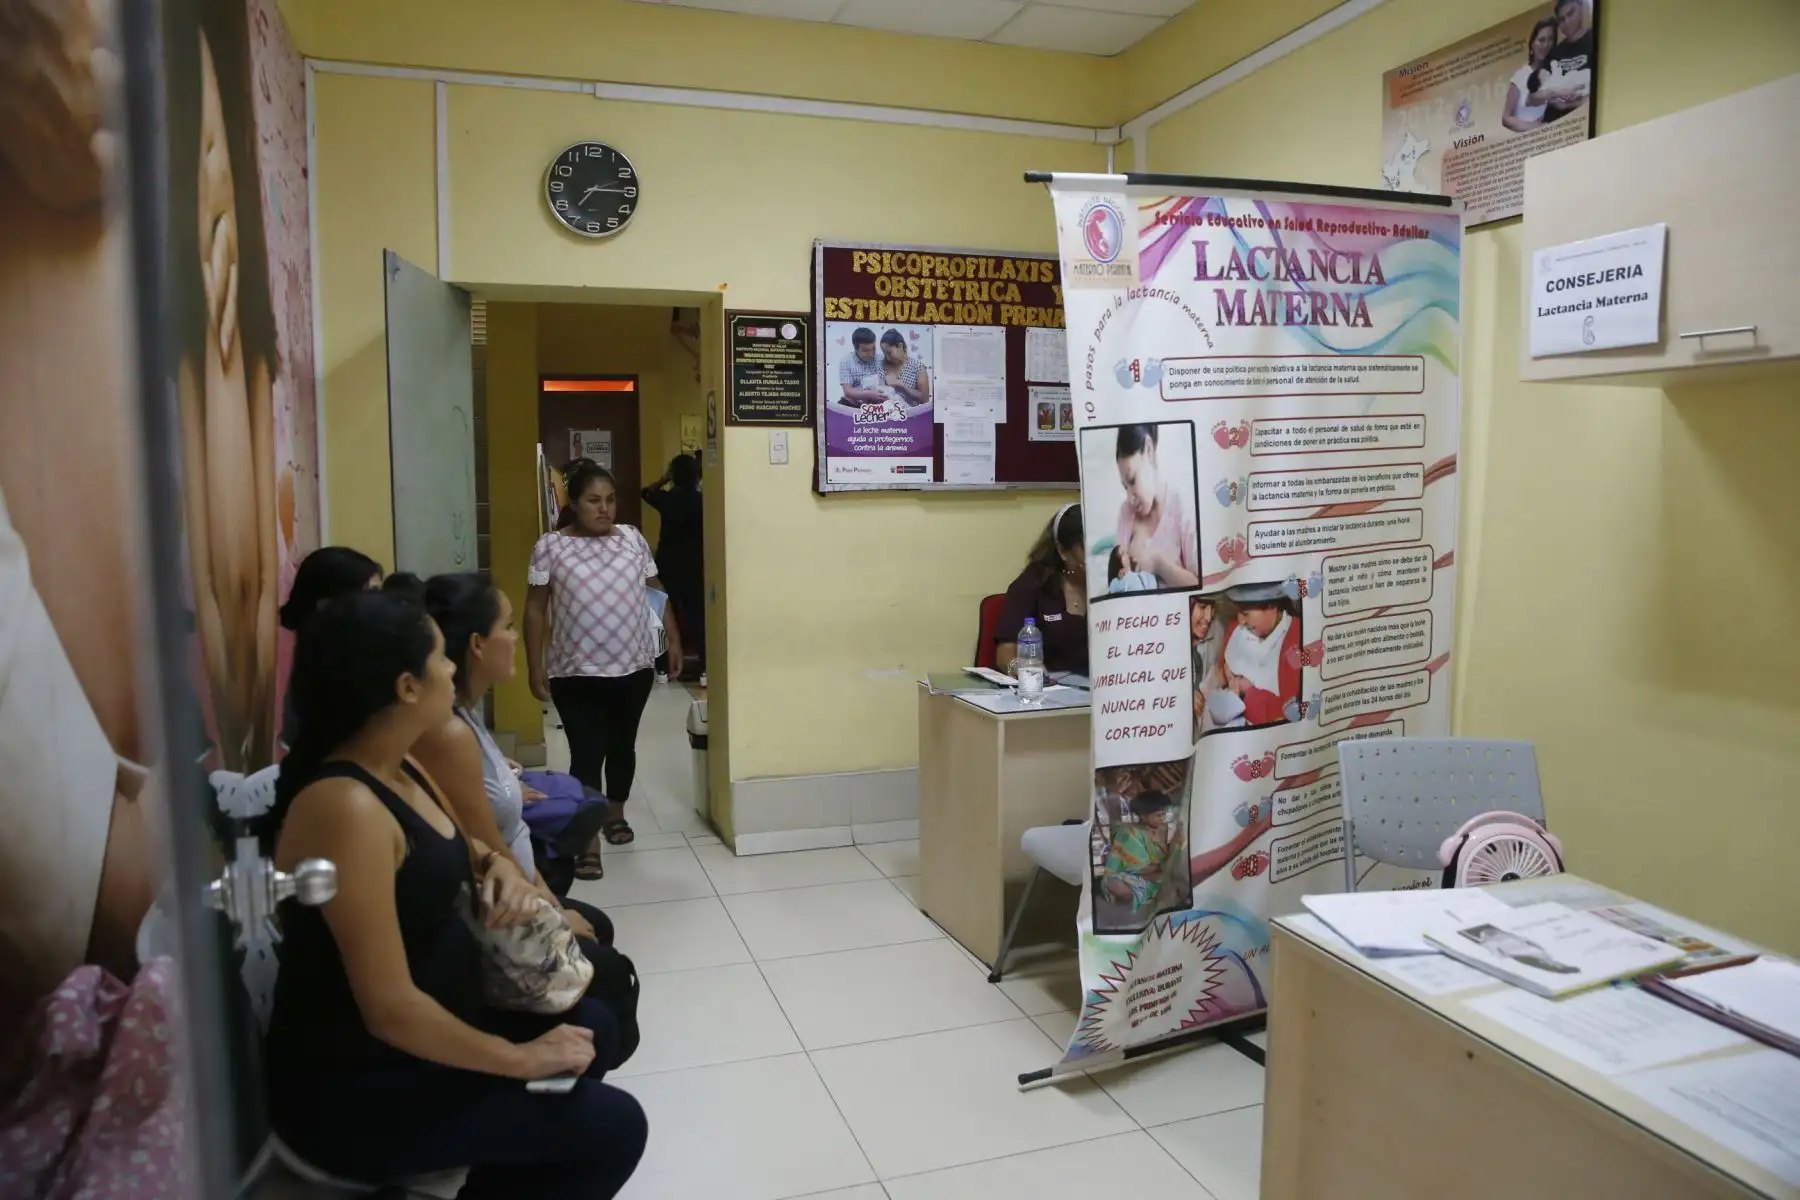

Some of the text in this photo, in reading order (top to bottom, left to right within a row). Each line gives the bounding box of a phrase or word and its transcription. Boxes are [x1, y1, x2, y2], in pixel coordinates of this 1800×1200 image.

[1453, 132, 1485, 150] Visión
[569, 152, 579, 163] 11
[585, 146, 602, 158] 12
[611, 152, 615, 163] 1
[555, 165, 572, 177] 10
[618, 167, 631, 178] 2
[550, 181, 564, 193] 9
[623, 186, 636, 198] 3
[556, 200, 569, 211] 8
[618, 204, 631, 215] 4
[568, 215, 581, 226] 7
[606, 217, 619, 228] 5
[1207, 212, 1265, 229] Educativo
[1267, 220, 1281, 230] en
[1284, 216, 1313, 232] Salud
[586, 222, 600, 233] 6
[851, 251, 1055, 283] PSICOPROFILAXIS
[1192, 240, 1389, 287] LACTANCIA
[1546, 264, 1643, 293] CONSEJERIA
[874, 275, 1022, 303] OBSTÉTRICA
[1213, 288, 1374, 329] MATERNA
[1537, 291, 1648, 317] Lactancia Materna
[824, 296, 993, 325] ESTIMULACIÓN
[1085, 286, 1214, 422] 10 pasos para la lactancia materna
[1169, 367, 1201, 376] Disponer
[1202, 366, 1211, 374] de
[1270, 364, 1295, 373] relativa
[1357, 365, 1367, 373] que
[1169, 380, 1192, 390] ponga
[1266, 376, 1295, 386] personal
[1295, 375, 1303, 384] de
[1329, 375, 1337, 384] de
[1293, 426, 1307, 434] todo
[1315, 424, 1340, 435] personal
[1350, 424, 1365, 432] salud
[1374, 423, 1388, 431] forma
[1390, 423, 1399, 432] que
[847, 436, 867, 445] ayuda
[1254, 435, 1350, 449] condiciones de poner práctica
[1288, 479, 1305, 487] todas
[1314, 475, 1350, 485] embarazadas
[1259, 491, 1290, 501] lactancia
[1325, 488, 1342, 496] forma
[1254, 529, 1280, 539] Ayudar
[1286, 528, 1296, 537] las
[1296, 527, 1316, 535] madres
[1322, 524, 1339, 533] iniciar
[1255, 540, 1287, 551] siguiente
[1116, 615, 1159, 630] PECHO
[1165, 612, 1182, 626] ES
[1367, 622, 1410, 635] nacidos que
[1383, 633, 1405, 642] alimento
[1107, 642, 1165, 659] EL LAZO
[1161, 667, 1188, 682] QUE
[1379, 694, 1394, 703] horas
[1101, 696, 1177, 715] NUNCA FUE
[1280, 748, 1308, 760] Fomentar
[1368, 728, 1393, 740] demanda
[1278, 797, 1287, 805] No
